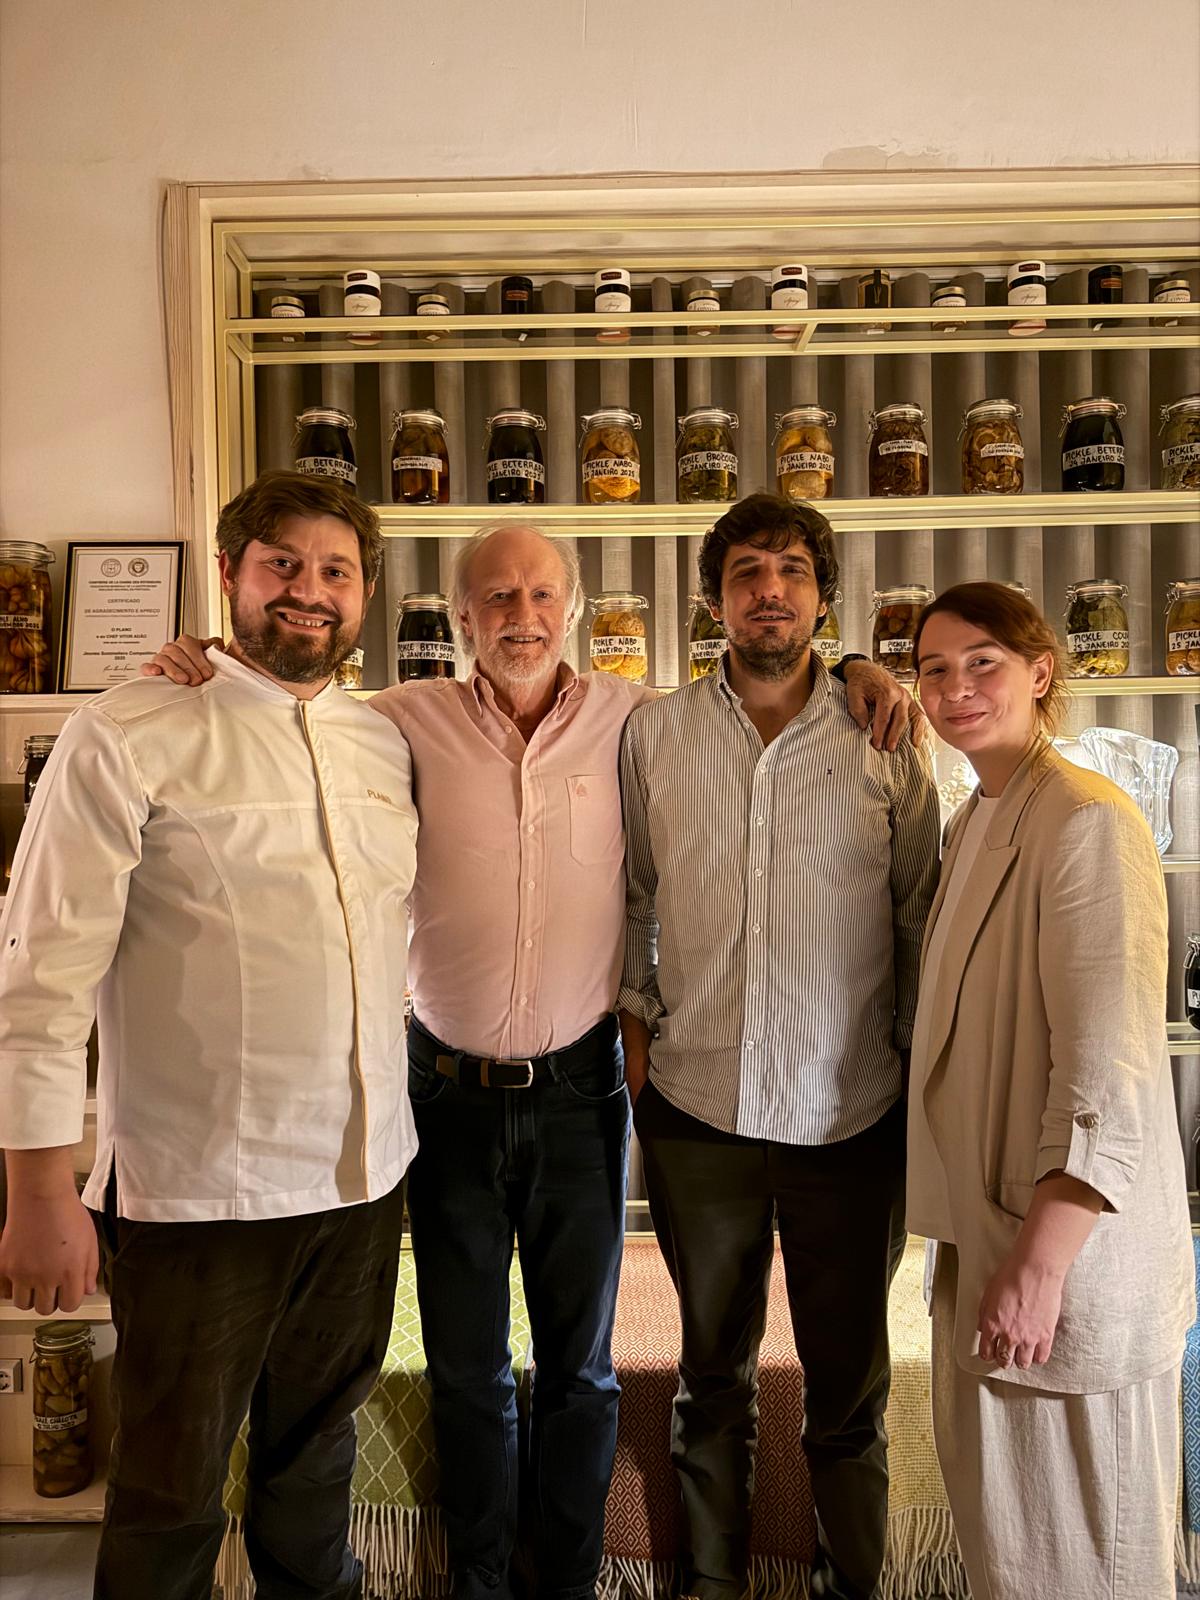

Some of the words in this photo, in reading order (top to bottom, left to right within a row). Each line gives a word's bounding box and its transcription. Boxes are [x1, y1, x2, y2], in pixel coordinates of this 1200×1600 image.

[1065, 447, 1091, 461] PICKLE
[586, 460, 609, 469] PICKLE
[780, 454, 804, 465] PICKLE
[810, 454, 829, 463] NABO
[1081, 456, 1115, 466] JANEIRO
[786, 462, 816, 472] JANEIRO
[591, 468, 618, 478] JANEIRO
[620, 469, 635, 477] 2025
[593, 638, 614, 647] PICKLE
[1074, 632, 1101, 643] PICKLE
[1084, 641, 1118, 650] JANEIRO
[596, 647, 623, 655] JANEIRO
